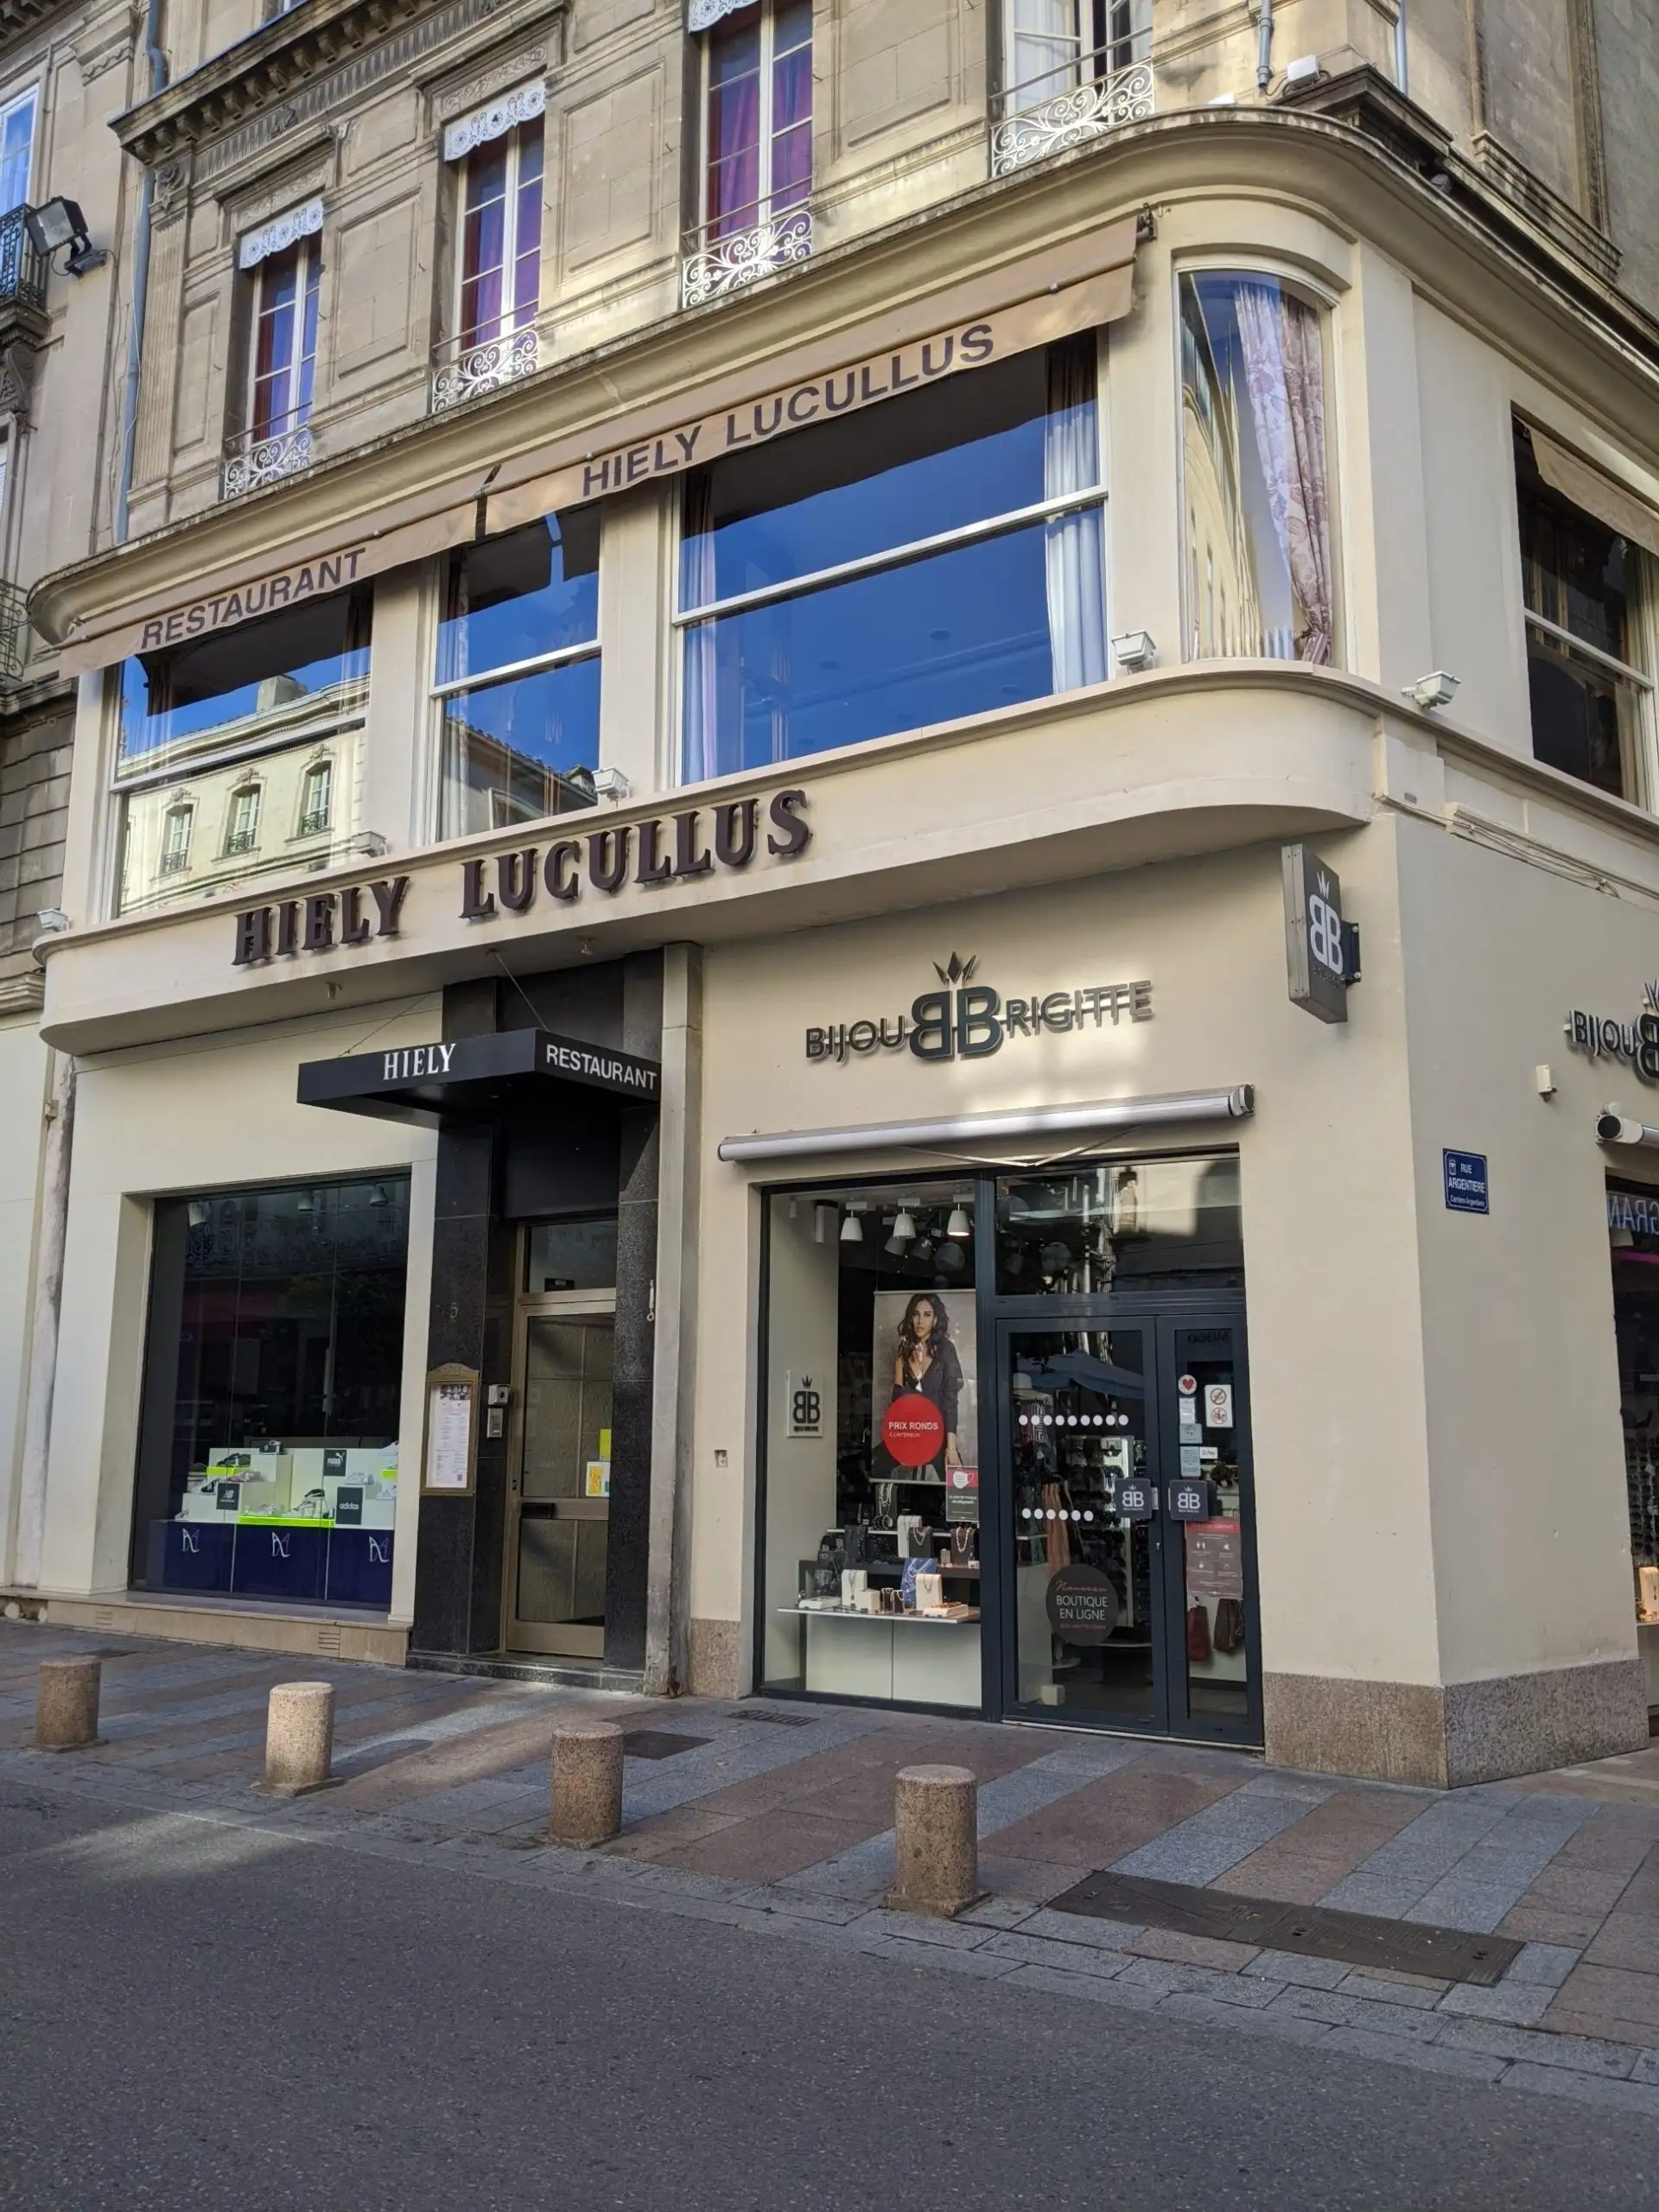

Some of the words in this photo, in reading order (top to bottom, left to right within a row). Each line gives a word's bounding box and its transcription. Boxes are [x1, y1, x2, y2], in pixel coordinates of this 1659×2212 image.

[582, 426, 702, 497] HIELY
[726, 323, 995, 447] LUCULLUS
[141, 549, 366, 650] RESTAURANT
[232, 876, 409, 966] HIELY
[461, 790, 813, 918] LUCULLUS
[383, 1043, 456, 1081] HIELY
[546, 1044, 658, 1090] RESTAURANT
[1460, 1163, 1472, 1174] RUE
[888, 1421, 907, 1430] PRIX
[909, 1421, 938, 1431] RONDS
[340, 1502, 360, 1510] adidas
[1056, 1595, 1109, 1607] BOUTIQUE
[1059, 1608, 1073, 1619] EN
[1076, 1609, 1107, 1621] LIGNE
